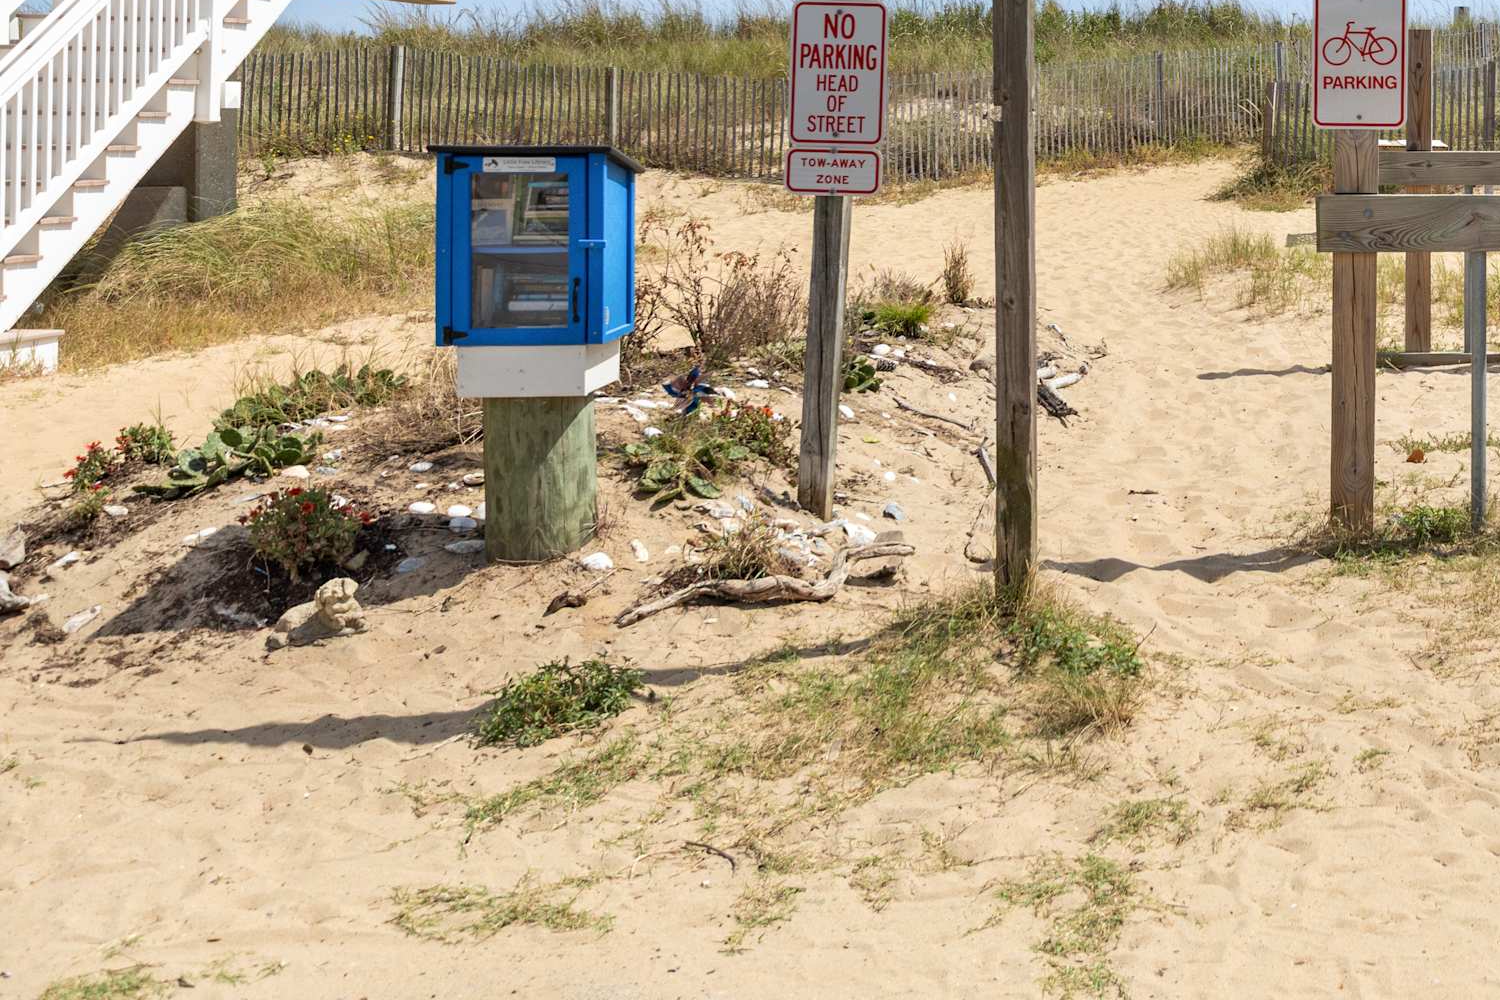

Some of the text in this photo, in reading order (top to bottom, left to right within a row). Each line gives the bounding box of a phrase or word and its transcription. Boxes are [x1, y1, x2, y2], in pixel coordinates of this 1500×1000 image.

[824, 13, 855, 39] NO
[800, 43, 877, 71] PARKING
[816, 74, 858, 92] HEAD
[1323, 76, 1397, 89] PARKING
[827, 95, 847, 113] OF
[807, 115, 866, 134] STREET
[801, 157, 866, 169] TOW-AWAY
[816, 175, 849, 185] ZONE
